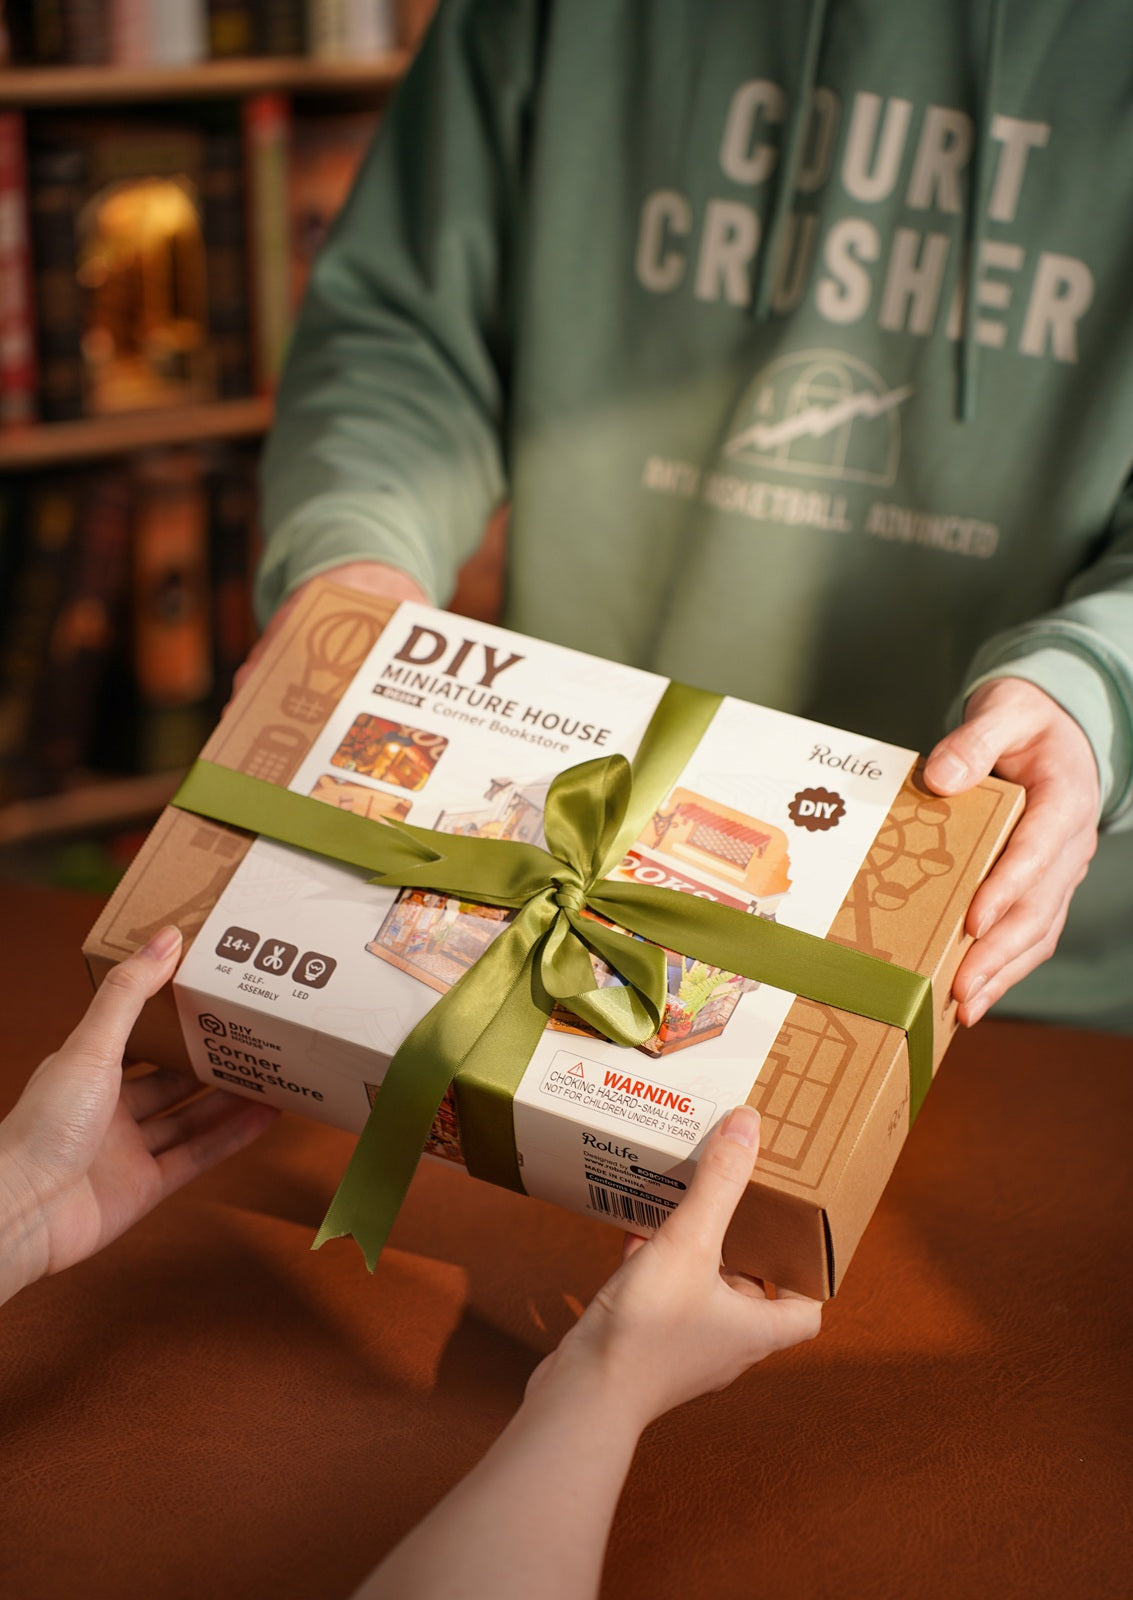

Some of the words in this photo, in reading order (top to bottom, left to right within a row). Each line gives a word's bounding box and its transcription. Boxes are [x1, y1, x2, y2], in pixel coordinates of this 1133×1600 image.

[719, 79, 1051, 223] COURT
[635, 188, 1096, 364] CRUSHER
[394, 625, 526, 688] DIY
[381, 664, 518, 718] MINIATURE
[521, 706, 612, 746] HOUSE
[432, 702, 486, 727] Corner
[489, 720, 571, 753] Bookstore
[808, 743, 883, 780] Rolife
[799, 800, 838, 819] DIY
[222, 935, 251, 952] 14+
[215, 963, 233, 975] AGE
[237, 982, 280, 1001] ASSEMBLY
[292, 988, 310, 1001] LED
[229, 1021, 252, 1036] DIY
[204, 1038, 282, 1073] Corner
[208, 1051, 325, 1103] Bookstore
[550, 1070, 596, 1094] CHOKING
[603, 1071, 696, 1116] WARNING:
[544, 1081, 566, 1094] NOT
[564, 1088, 583, 1102] FOR
[583, 1095, 628, 1117] CHILDREN
[628, 1110, 659, 1128] UNDER
[658, 1122, 667, 1131] 3
[582, 1132, 639, 1162] Rolife
[584, 1163, 608, 1176] MADE
[608, 1172, 617, 1180] IN
